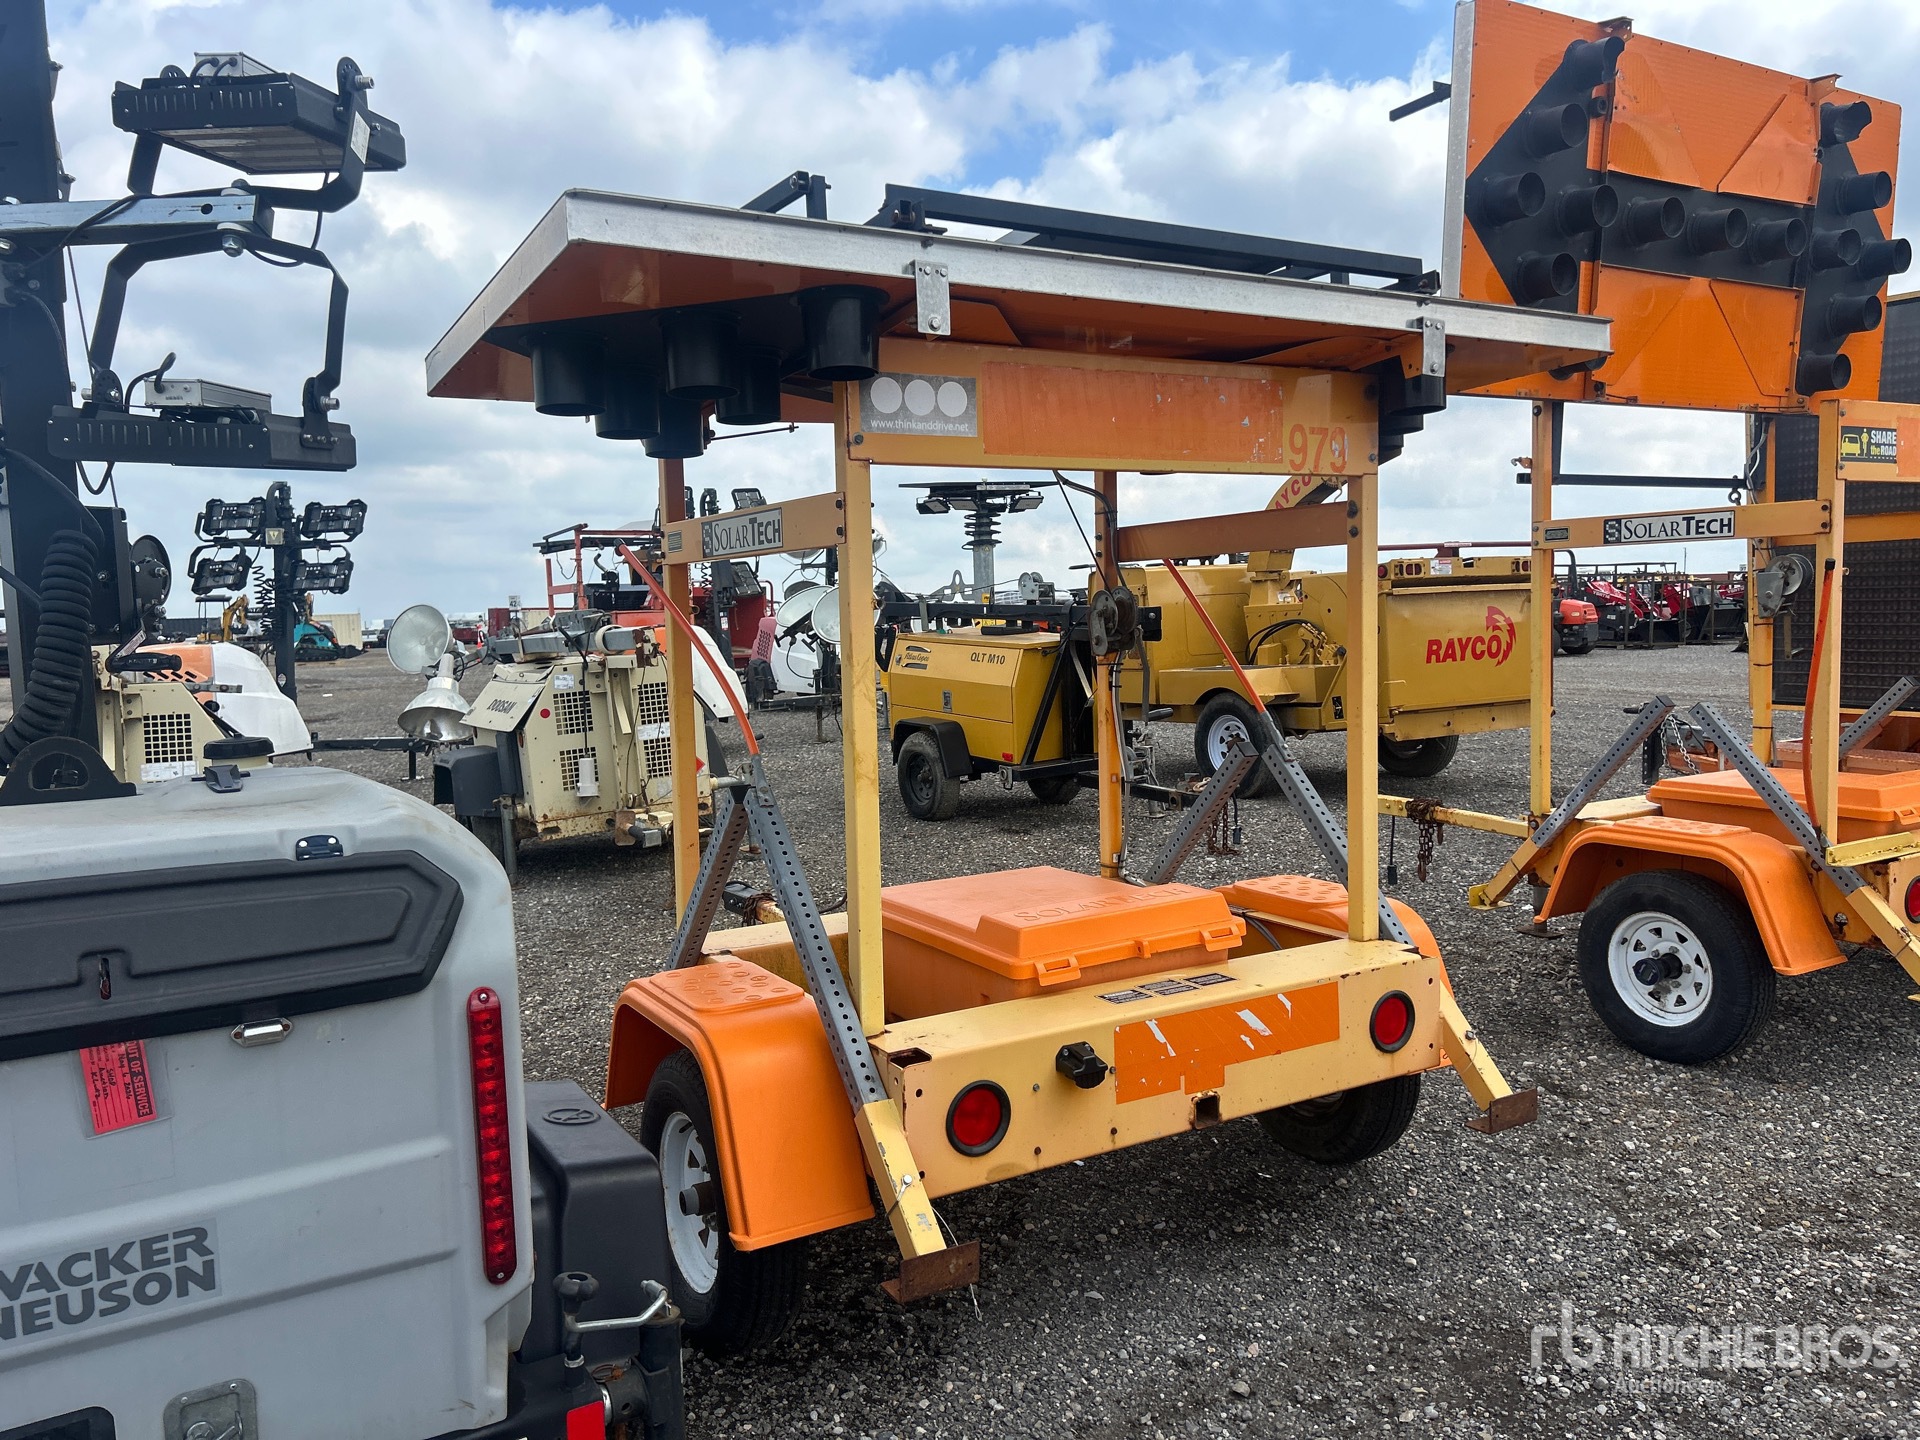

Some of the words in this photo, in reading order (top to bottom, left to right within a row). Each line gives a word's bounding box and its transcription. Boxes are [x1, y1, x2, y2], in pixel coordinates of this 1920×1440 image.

[869, 418, 970, 432] www.thinkanddrive.net
[1870, 429, 1897, 445] SHARE
[1288, 423, 1348, 474] 979
[1870, 444, 1880, 456] the
[1880, 445, 1897, 456] ROAD
[713, 517, 781, 552] SOLARTECH
[1623, 516, 1732, 540] SOLARTECH
[970, 652, 987, 663] QLT
[987, 653, 1006, 665] M10
[1425, 634, 1502, 665] RAYCO
[1013, 888, 1192, 922] SOLARTECH
[130, 1060, 143, 1074] OF
[133, 1075, 151, 1117] SERVICE
